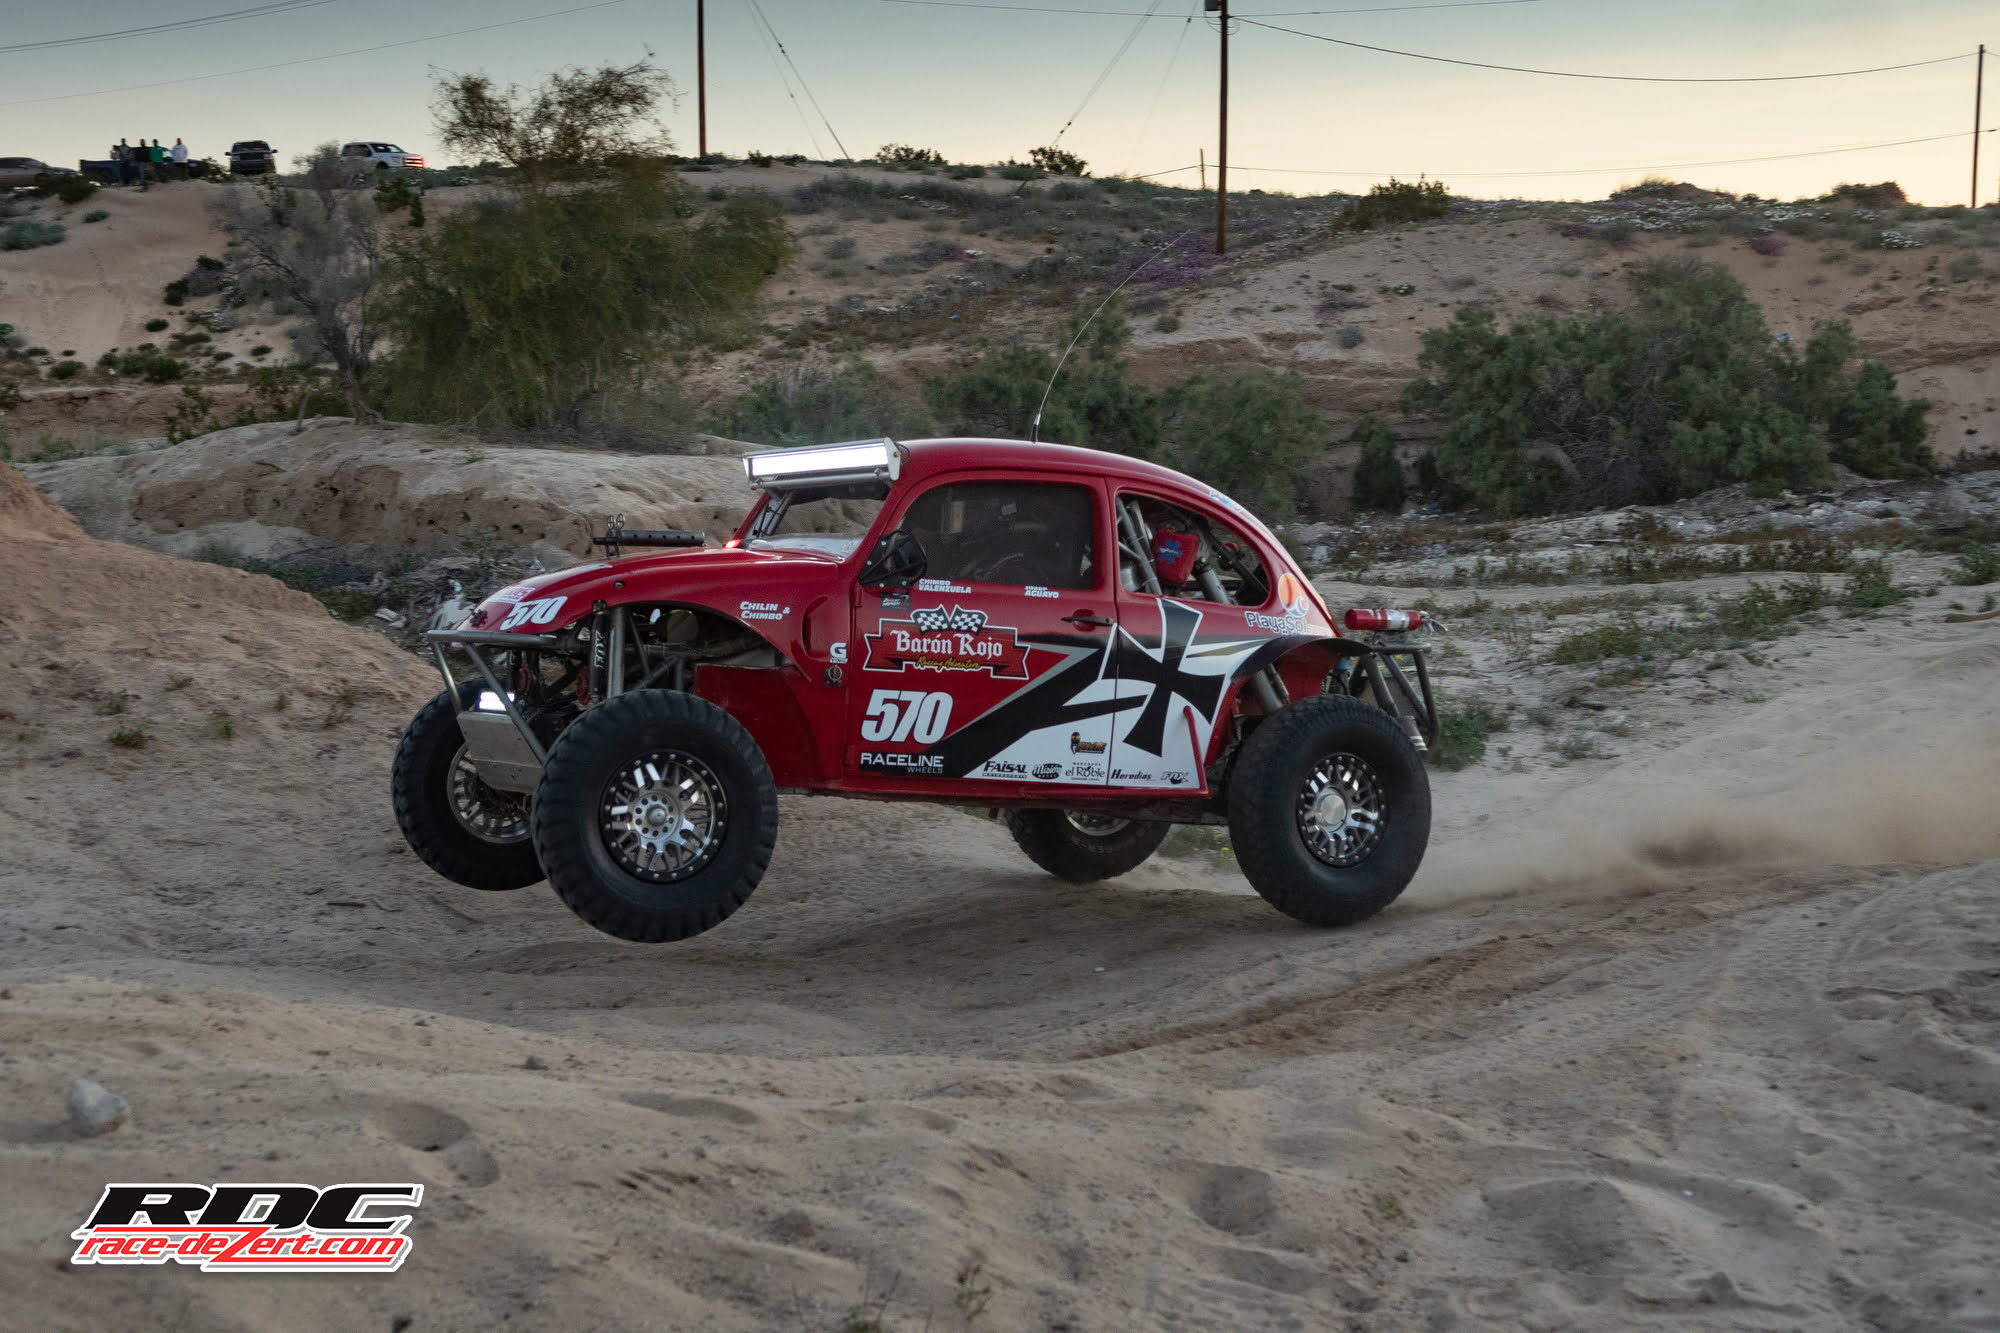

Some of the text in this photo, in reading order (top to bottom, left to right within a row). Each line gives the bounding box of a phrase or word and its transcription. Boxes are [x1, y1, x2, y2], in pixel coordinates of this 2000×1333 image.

[919, 578, 951, 586] CHIMBO
[918, 584, 972, 594] VALENZUELA
[1024, 590, 1060, 599] AGUAYO
[499, 595, 569, 631] 570
[740, 601, 791, 614] CHILIN &
[741, 611, 783, 620] CHIMBO
[1245, 611, 1308, 635] PlayaSol
[829, 642, 847, 660] G
[890, 630, 1003, 660] Barón Rojo
[915, 656, 944, 670] Racing
[860, 688, 954, 744] 570
[859, 752, 945, 768] RACELINE
[907, 766, 944, 774] WHEELS
[983, 760, 1028, 774] FAISAL
[1065, 767, 1075, 777] el
[1076, 765, 1105, 778] Roble
[1110, 768, 1152, 780] Heredias
